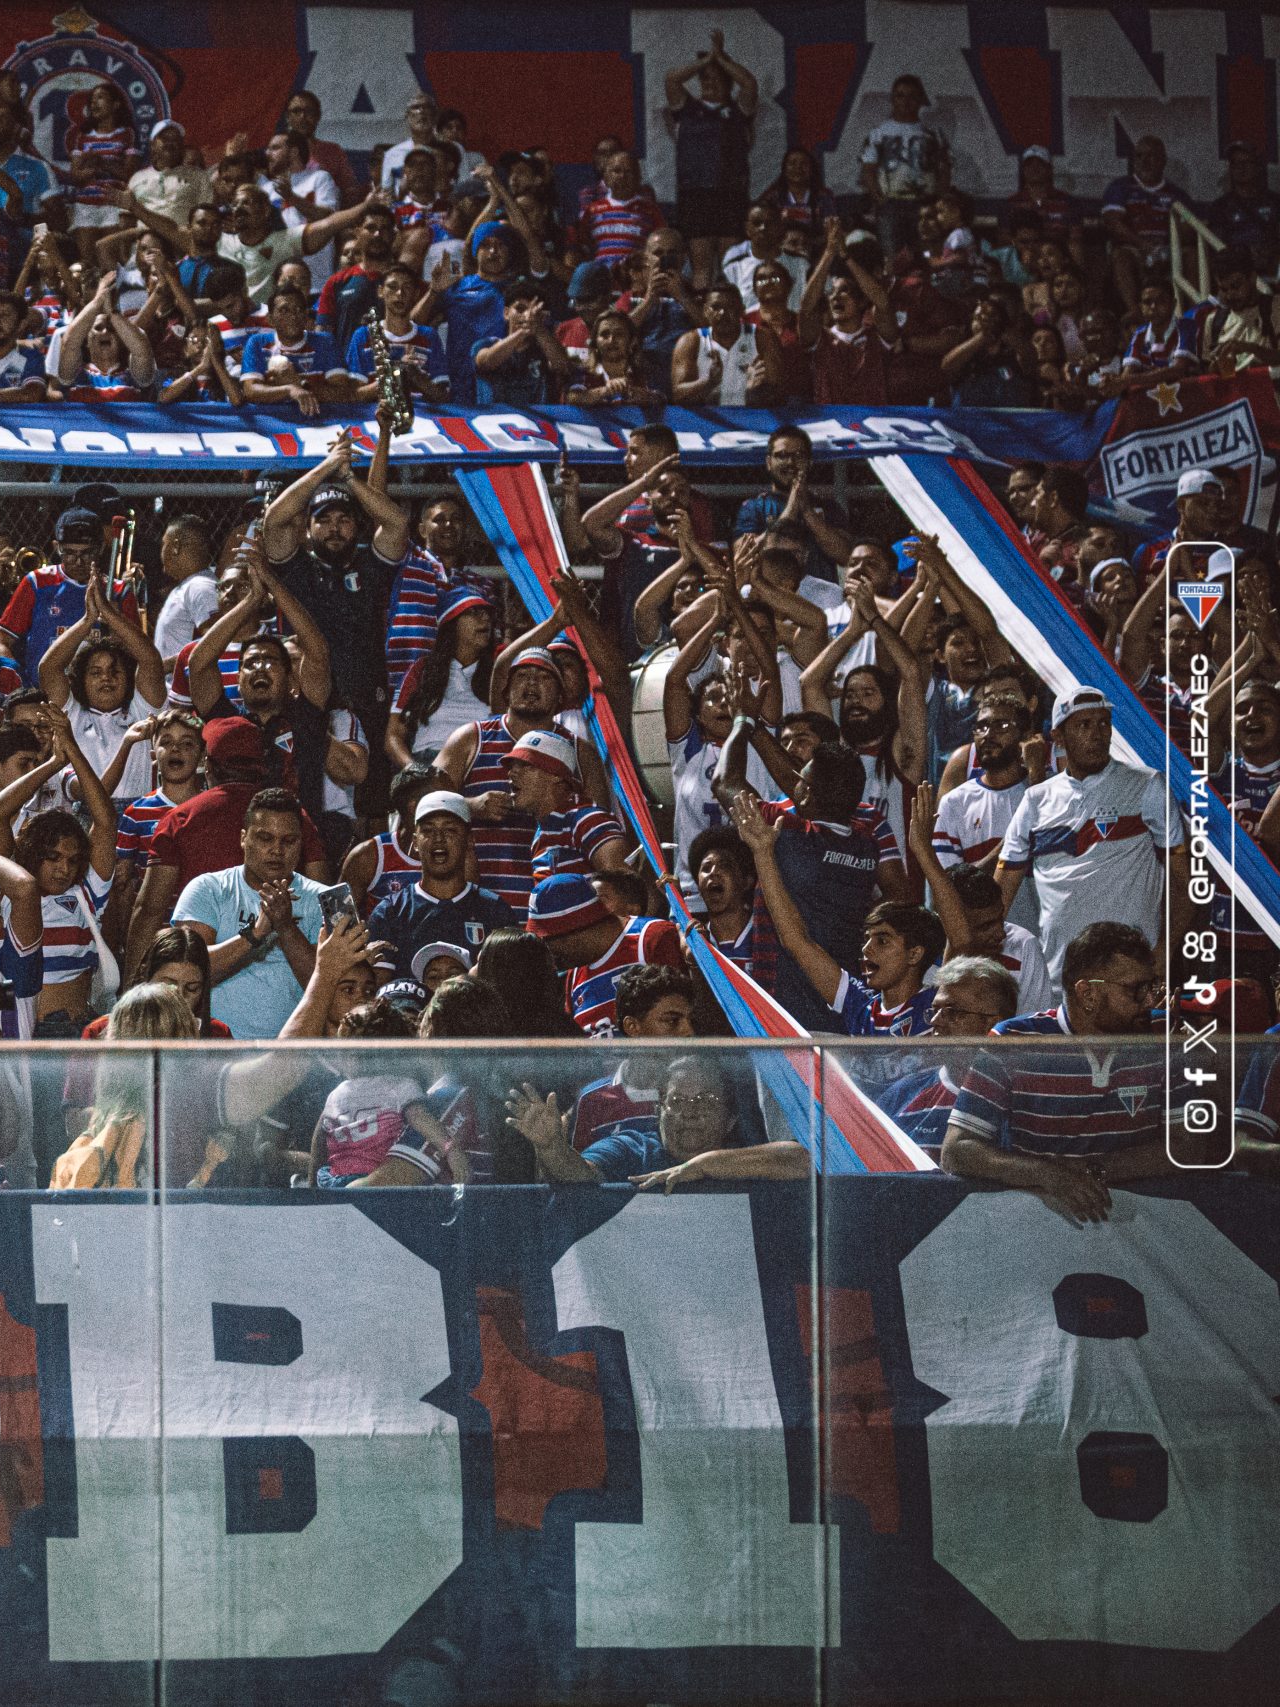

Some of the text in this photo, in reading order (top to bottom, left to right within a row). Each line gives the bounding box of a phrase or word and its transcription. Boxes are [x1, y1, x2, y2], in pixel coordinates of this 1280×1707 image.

[1114, 419, 1250, 484] FORTALEZA
[375, 980, 426, 999] BRAVO
[31, 1190, 1280, 1662] B18
